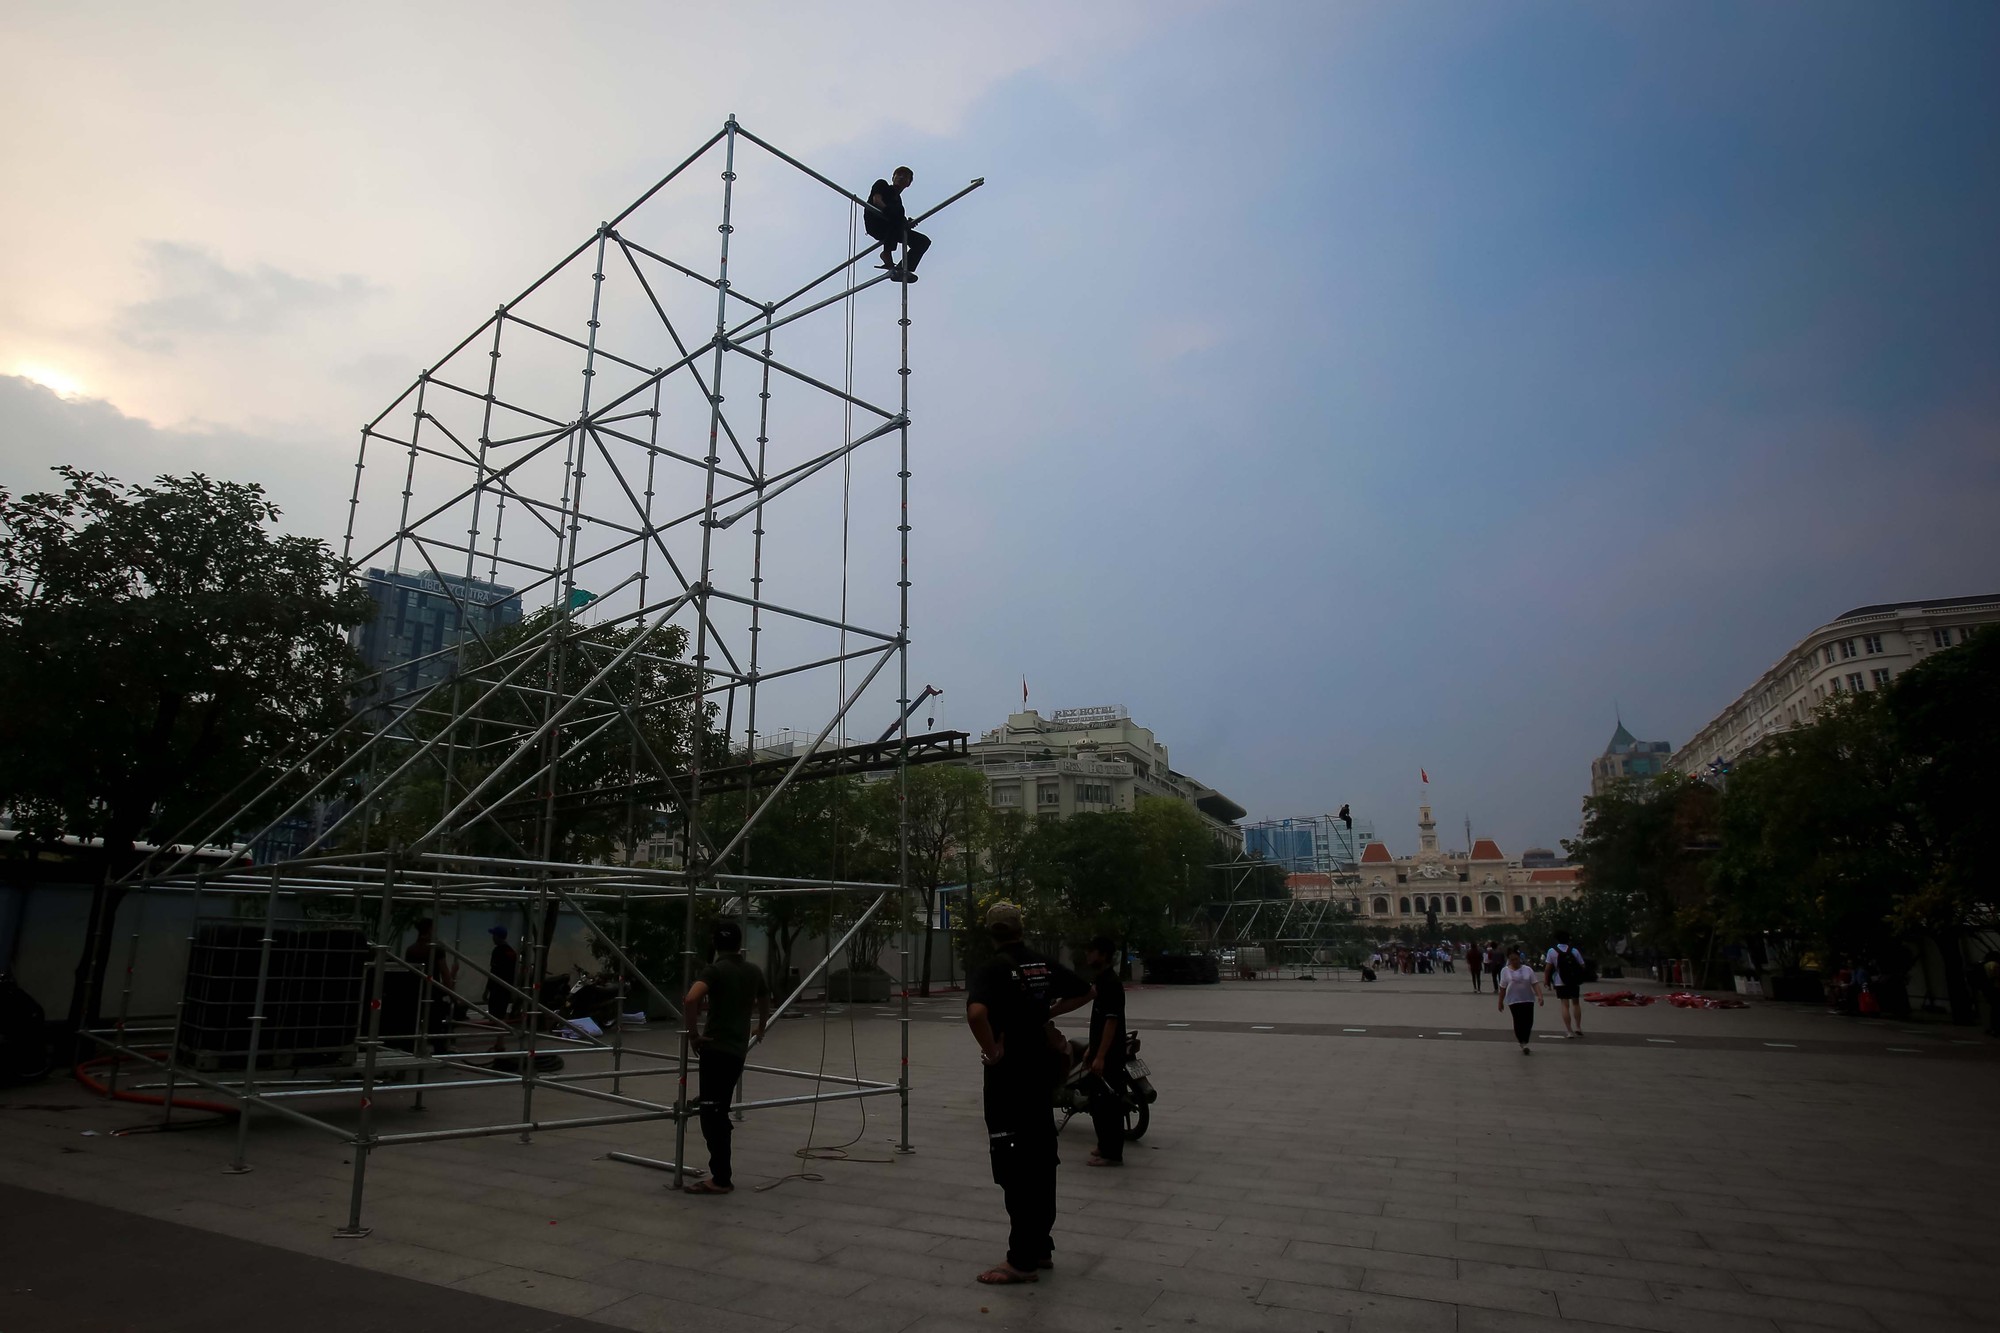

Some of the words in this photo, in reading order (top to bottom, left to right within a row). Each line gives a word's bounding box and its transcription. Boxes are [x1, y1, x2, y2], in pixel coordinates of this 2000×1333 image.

[1055, 709, 1077, 718] REX
[1080, 707, 1115, 715] HOTEL
[1064, 762, 1083, 772] REX
[1089, 764, 1128, 774] HOTEL
